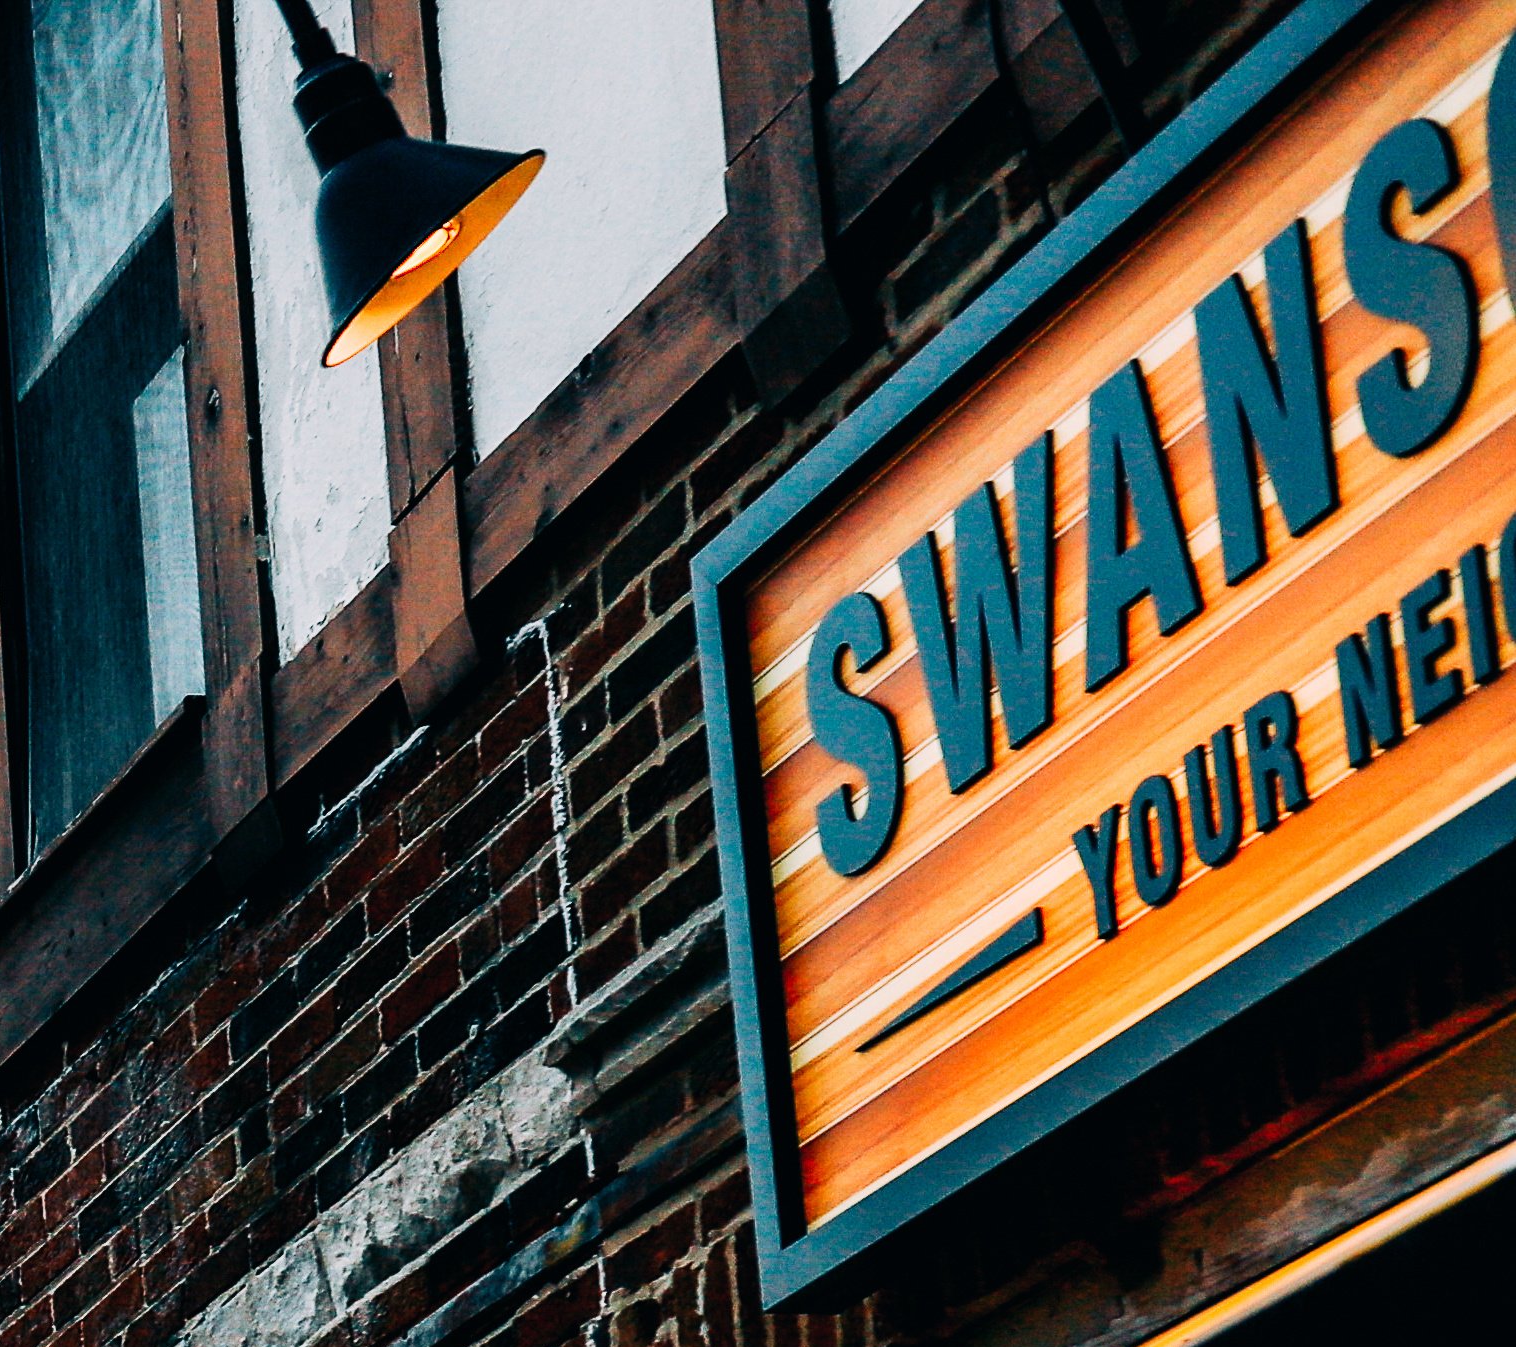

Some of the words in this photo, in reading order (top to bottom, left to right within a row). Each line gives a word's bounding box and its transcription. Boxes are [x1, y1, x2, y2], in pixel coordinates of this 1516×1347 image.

[804, 25, 1516, 877] SWANS
[1072, 690, 1314, 943] YOUR
[1335, 510, 1516, 770] NEI
